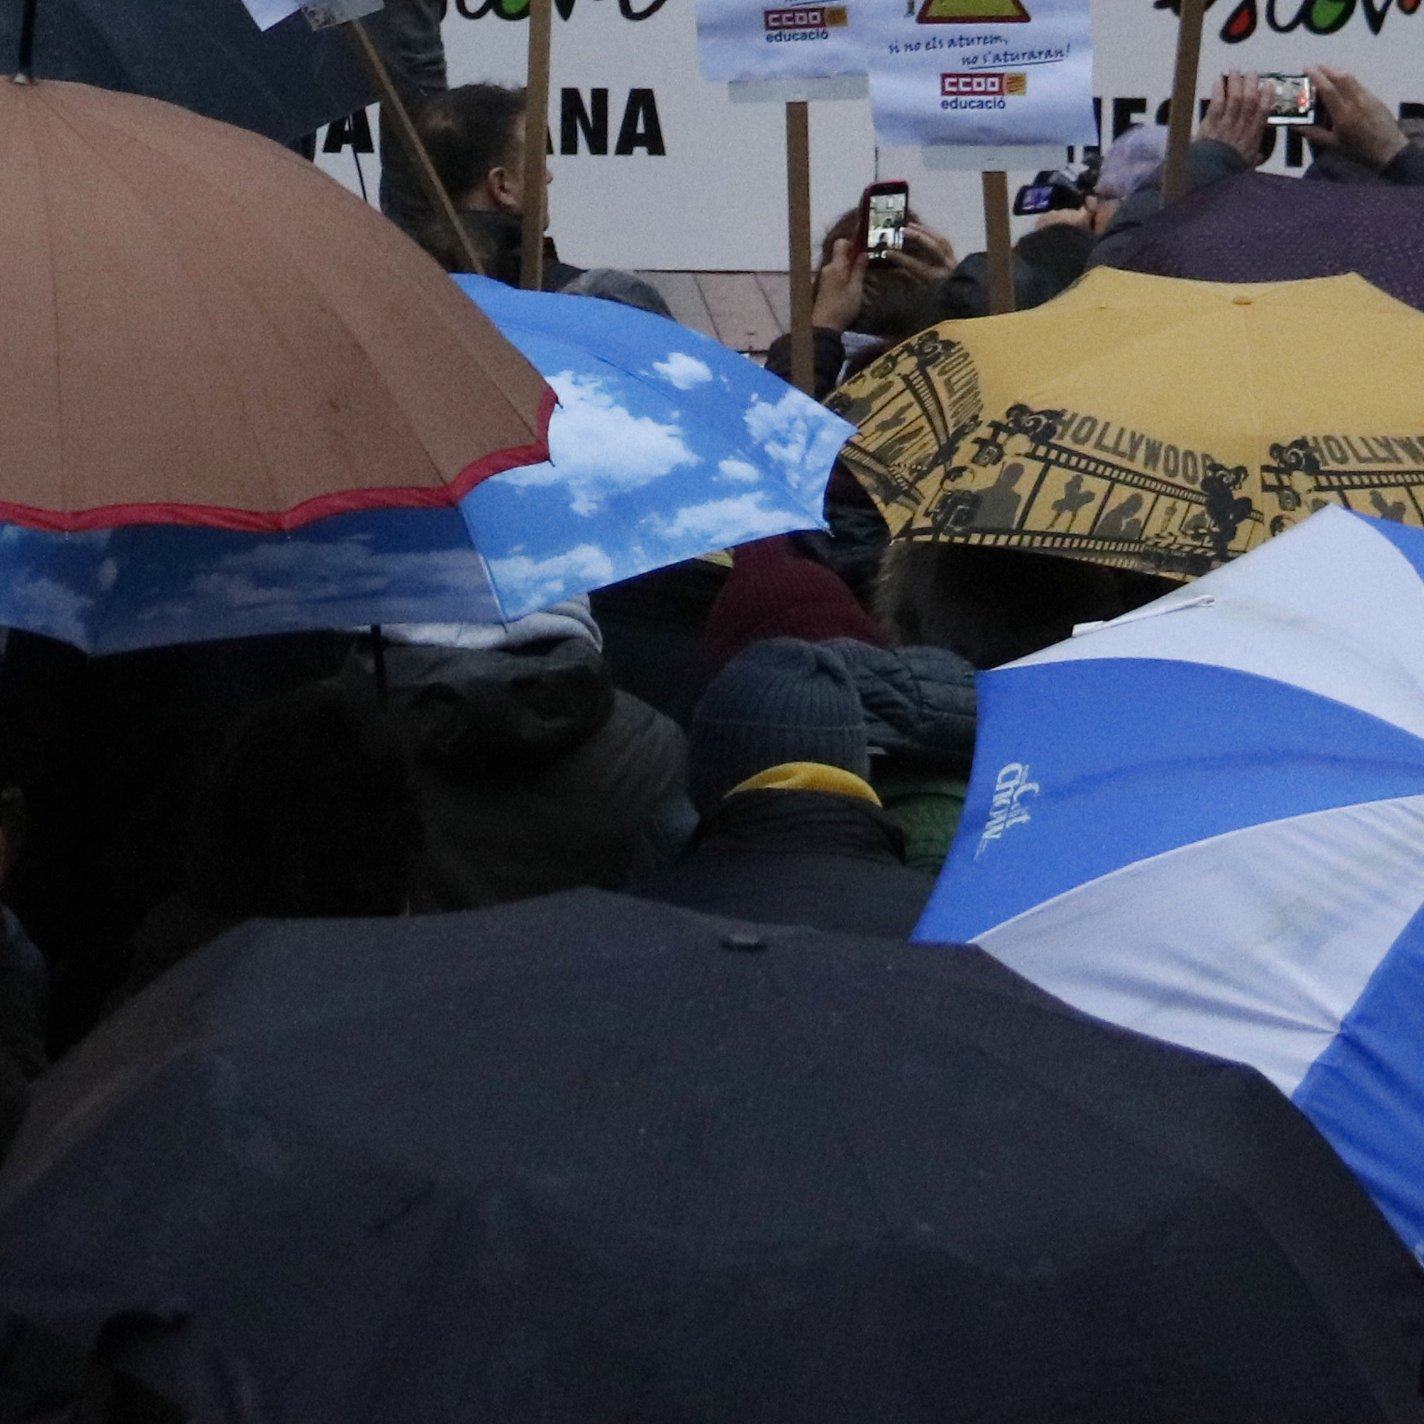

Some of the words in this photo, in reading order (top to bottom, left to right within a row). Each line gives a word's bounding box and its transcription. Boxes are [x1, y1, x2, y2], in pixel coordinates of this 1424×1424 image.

[766, 29, 828, 43] educació
[903, 41, 922, 52] no
[925, 36, 944, 51] els
[962, 55, 980, 66] no
[940, 96, 1006, 110] educació
